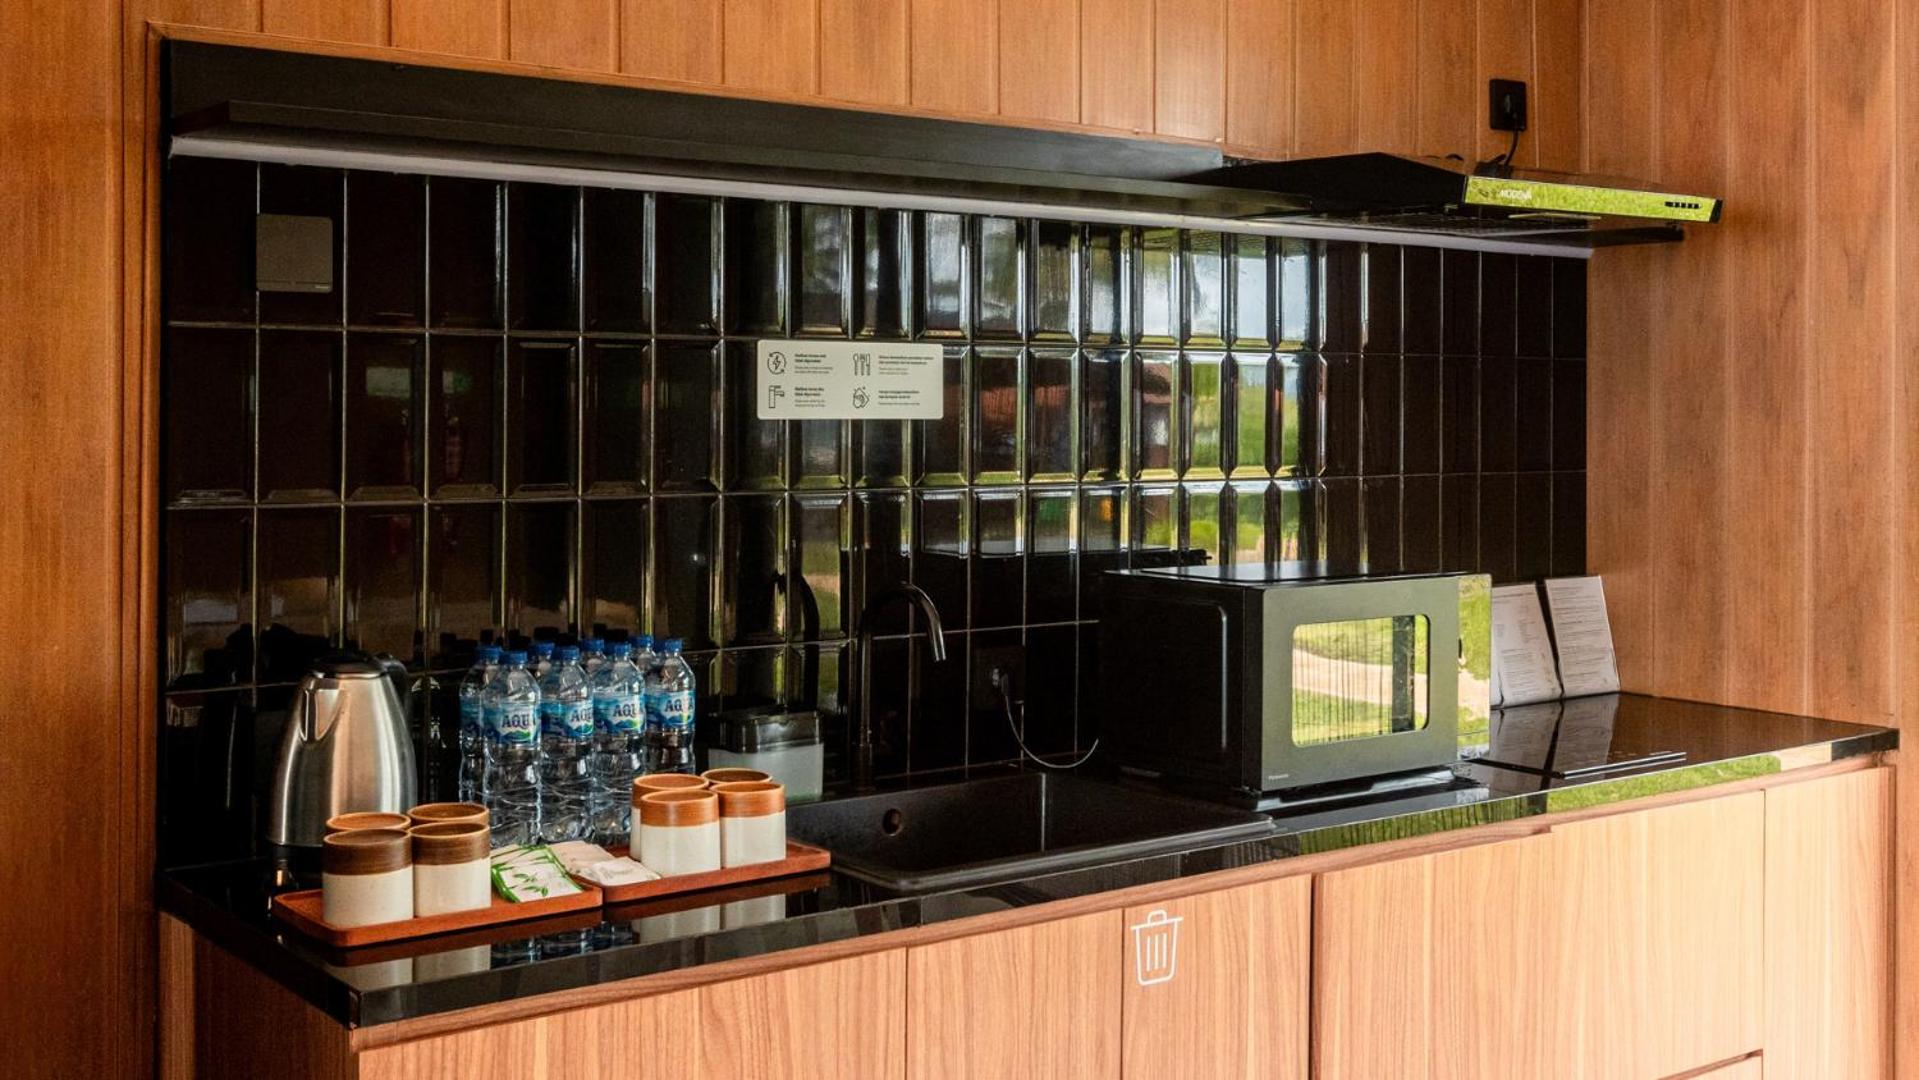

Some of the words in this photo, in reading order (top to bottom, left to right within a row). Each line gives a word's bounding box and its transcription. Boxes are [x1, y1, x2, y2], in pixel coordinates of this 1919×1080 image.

[612, 703, 641, 719] AQU
[664, 698, 694, 713] AQA
[501, 713, 536, 729] AQU
